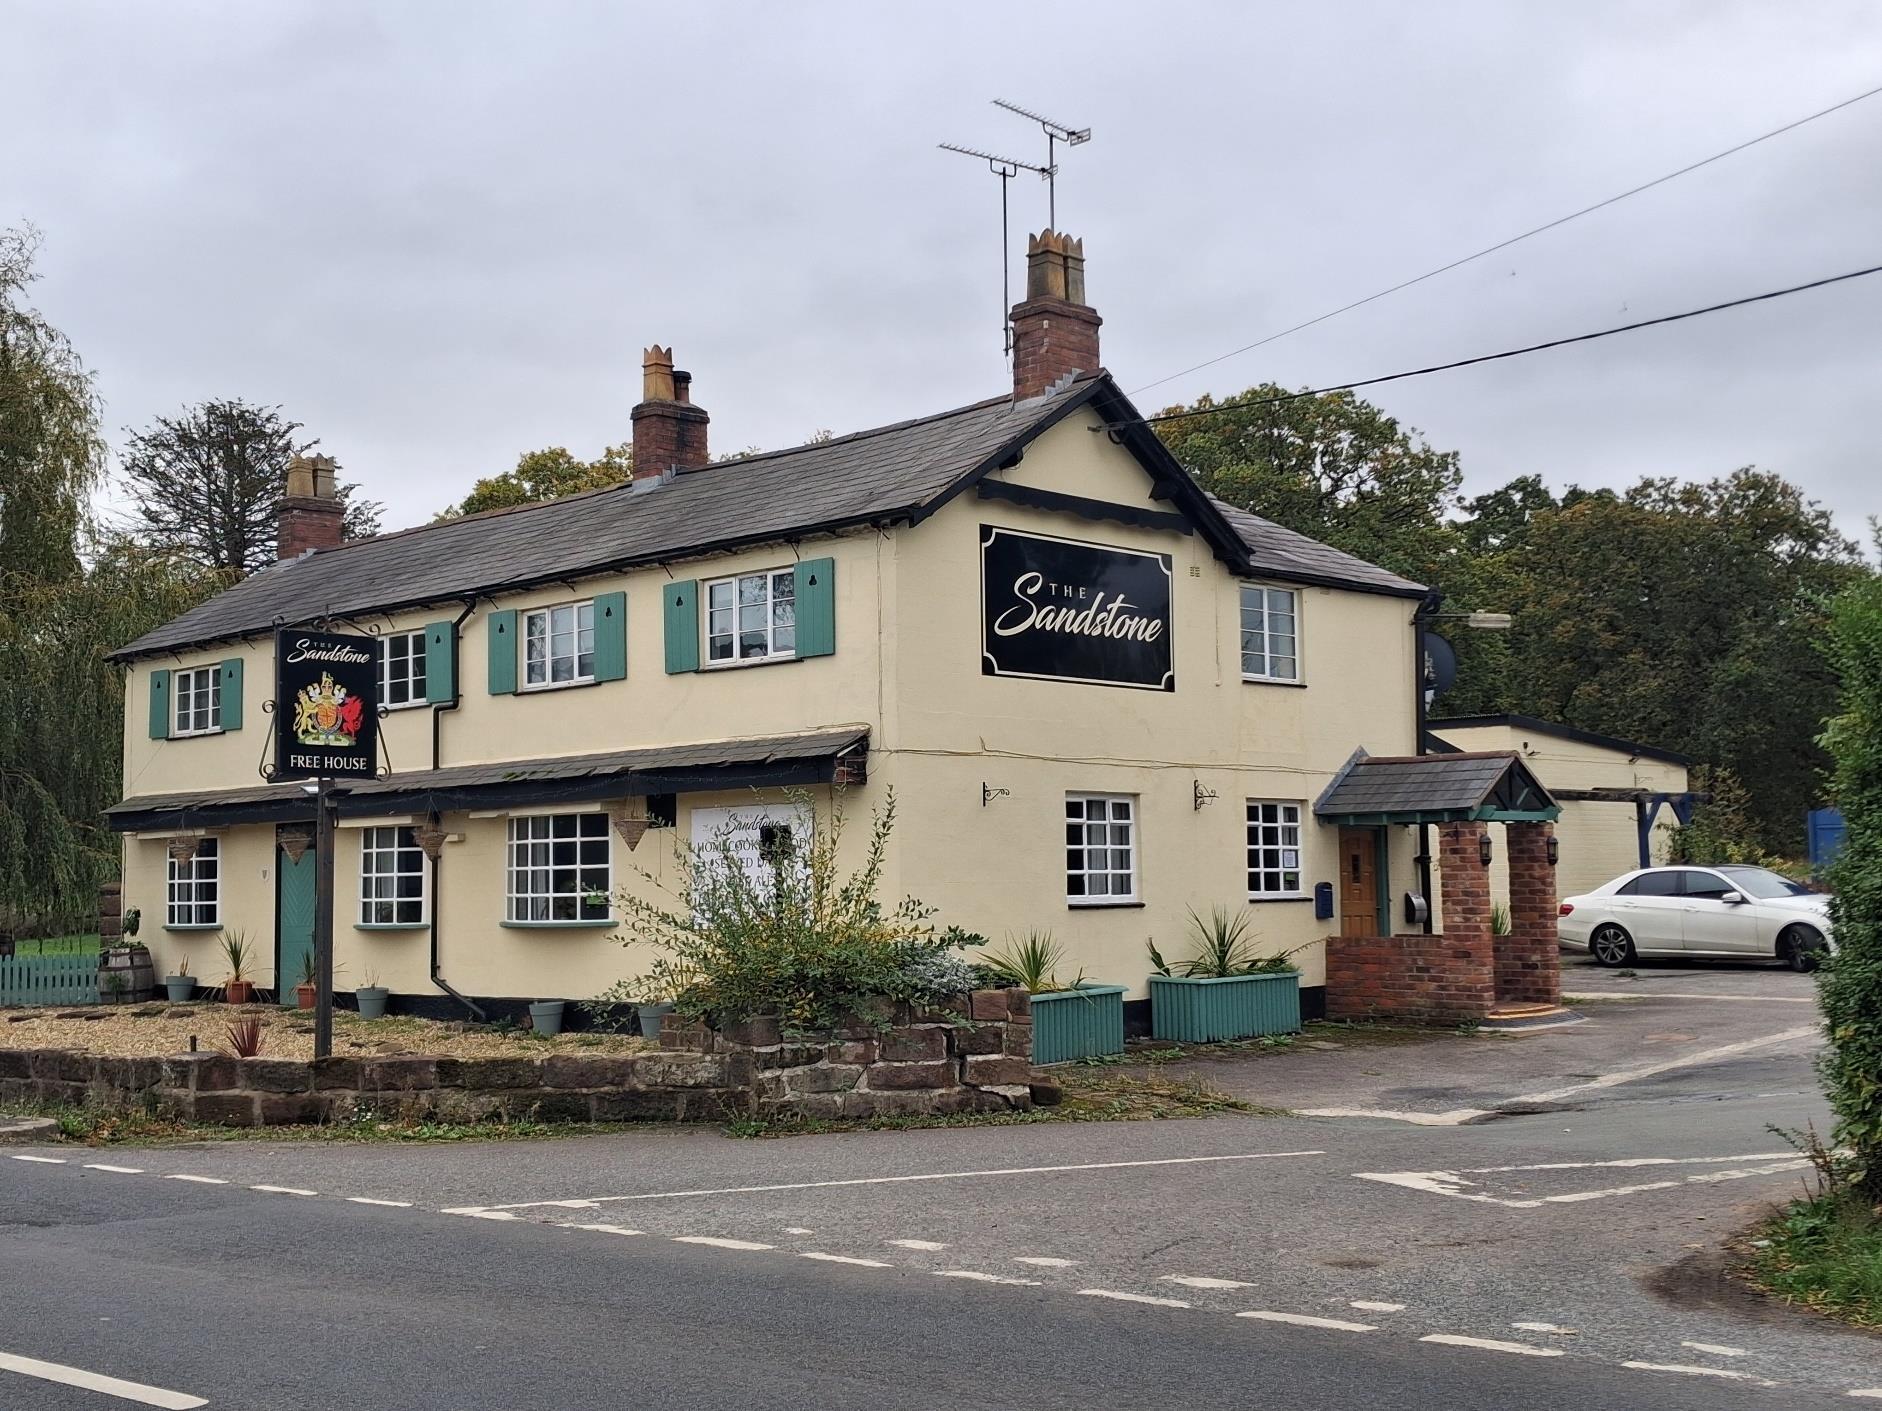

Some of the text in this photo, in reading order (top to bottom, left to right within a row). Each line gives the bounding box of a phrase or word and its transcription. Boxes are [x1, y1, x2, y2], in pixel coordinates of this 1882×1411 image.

[1048, 583, 1088, 599] THE
[994, 571, 1163, 643] Sandstone
[286, 638, 371, 664] Sandstone
[290, 754, 367, 770] FREE HOUSE
